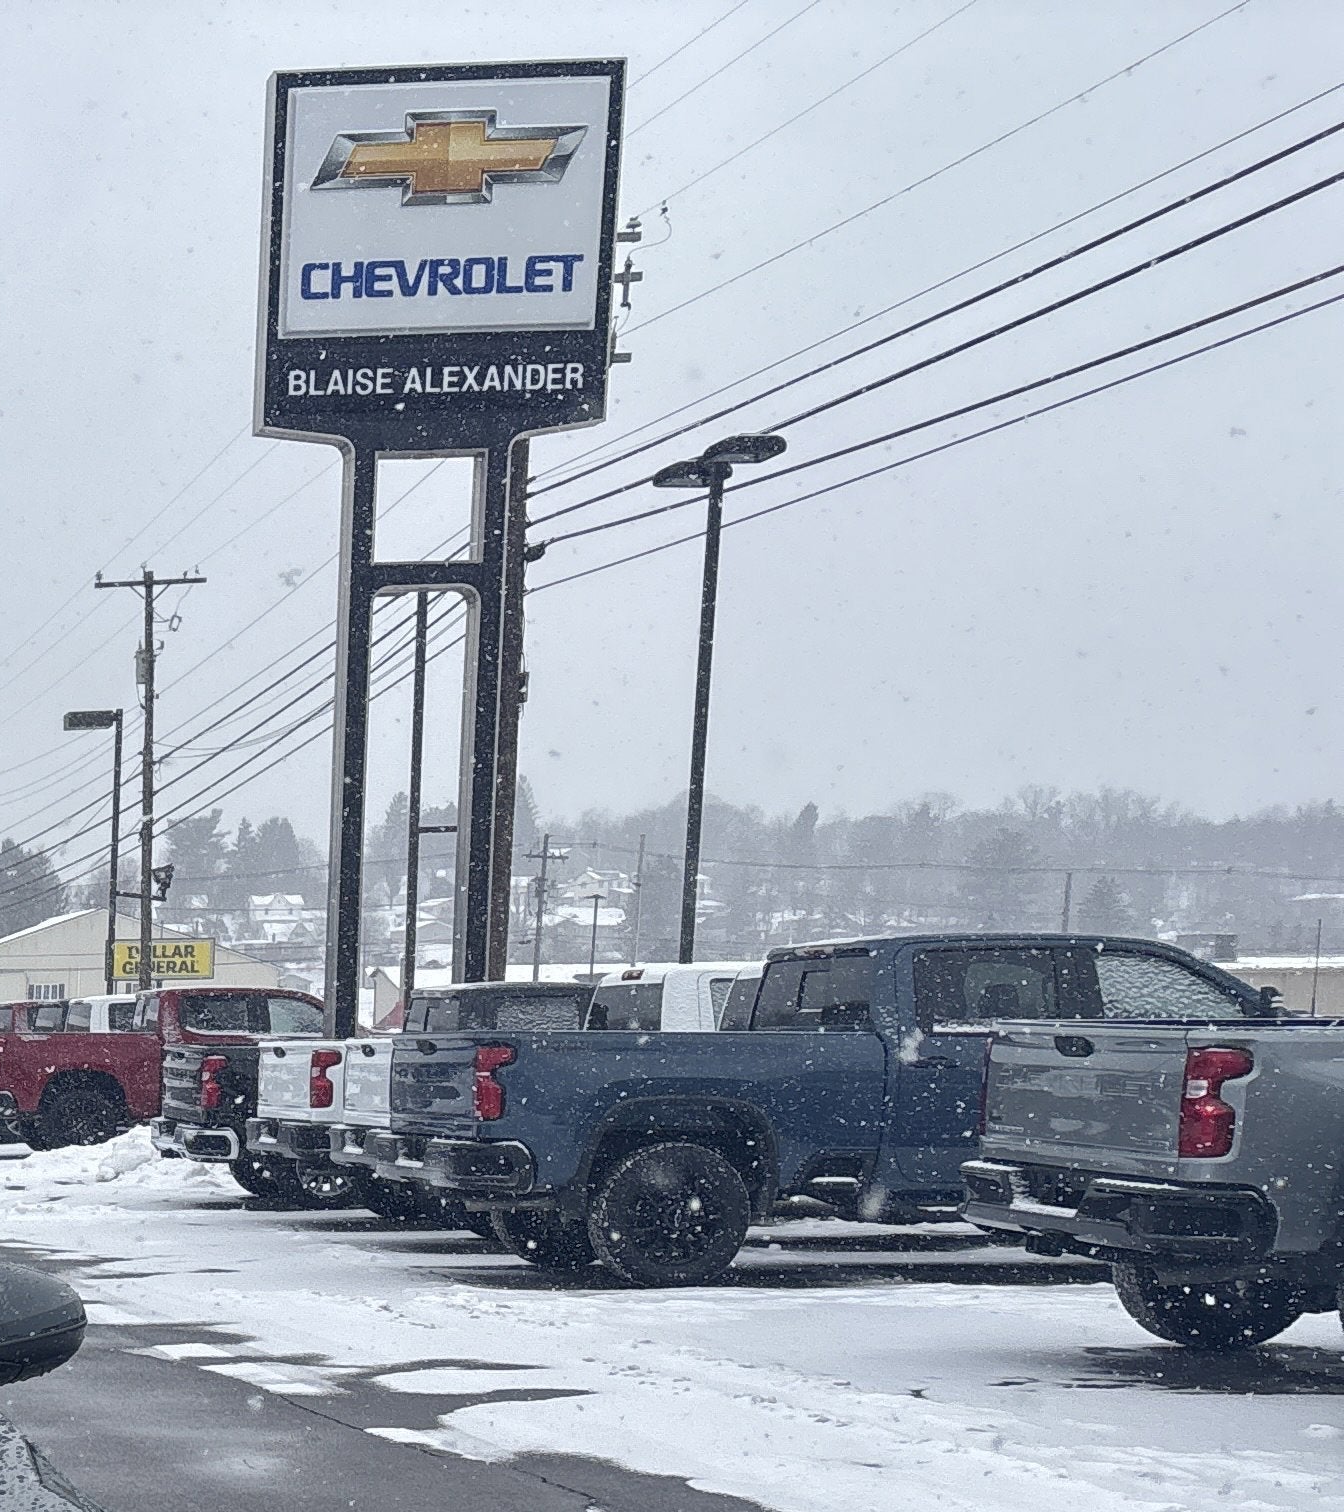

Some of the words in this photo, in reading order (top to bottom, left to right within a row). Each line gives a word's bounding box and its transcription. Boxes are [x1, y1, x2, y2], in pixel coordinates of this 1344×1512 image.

[300, 254, 584, 300] CHEVROLET
[287, 368, 394, 396] BLAISE
[403, 363, 584, 394] ALEXANDER
[127, 945, 196, 960] DLLAR
